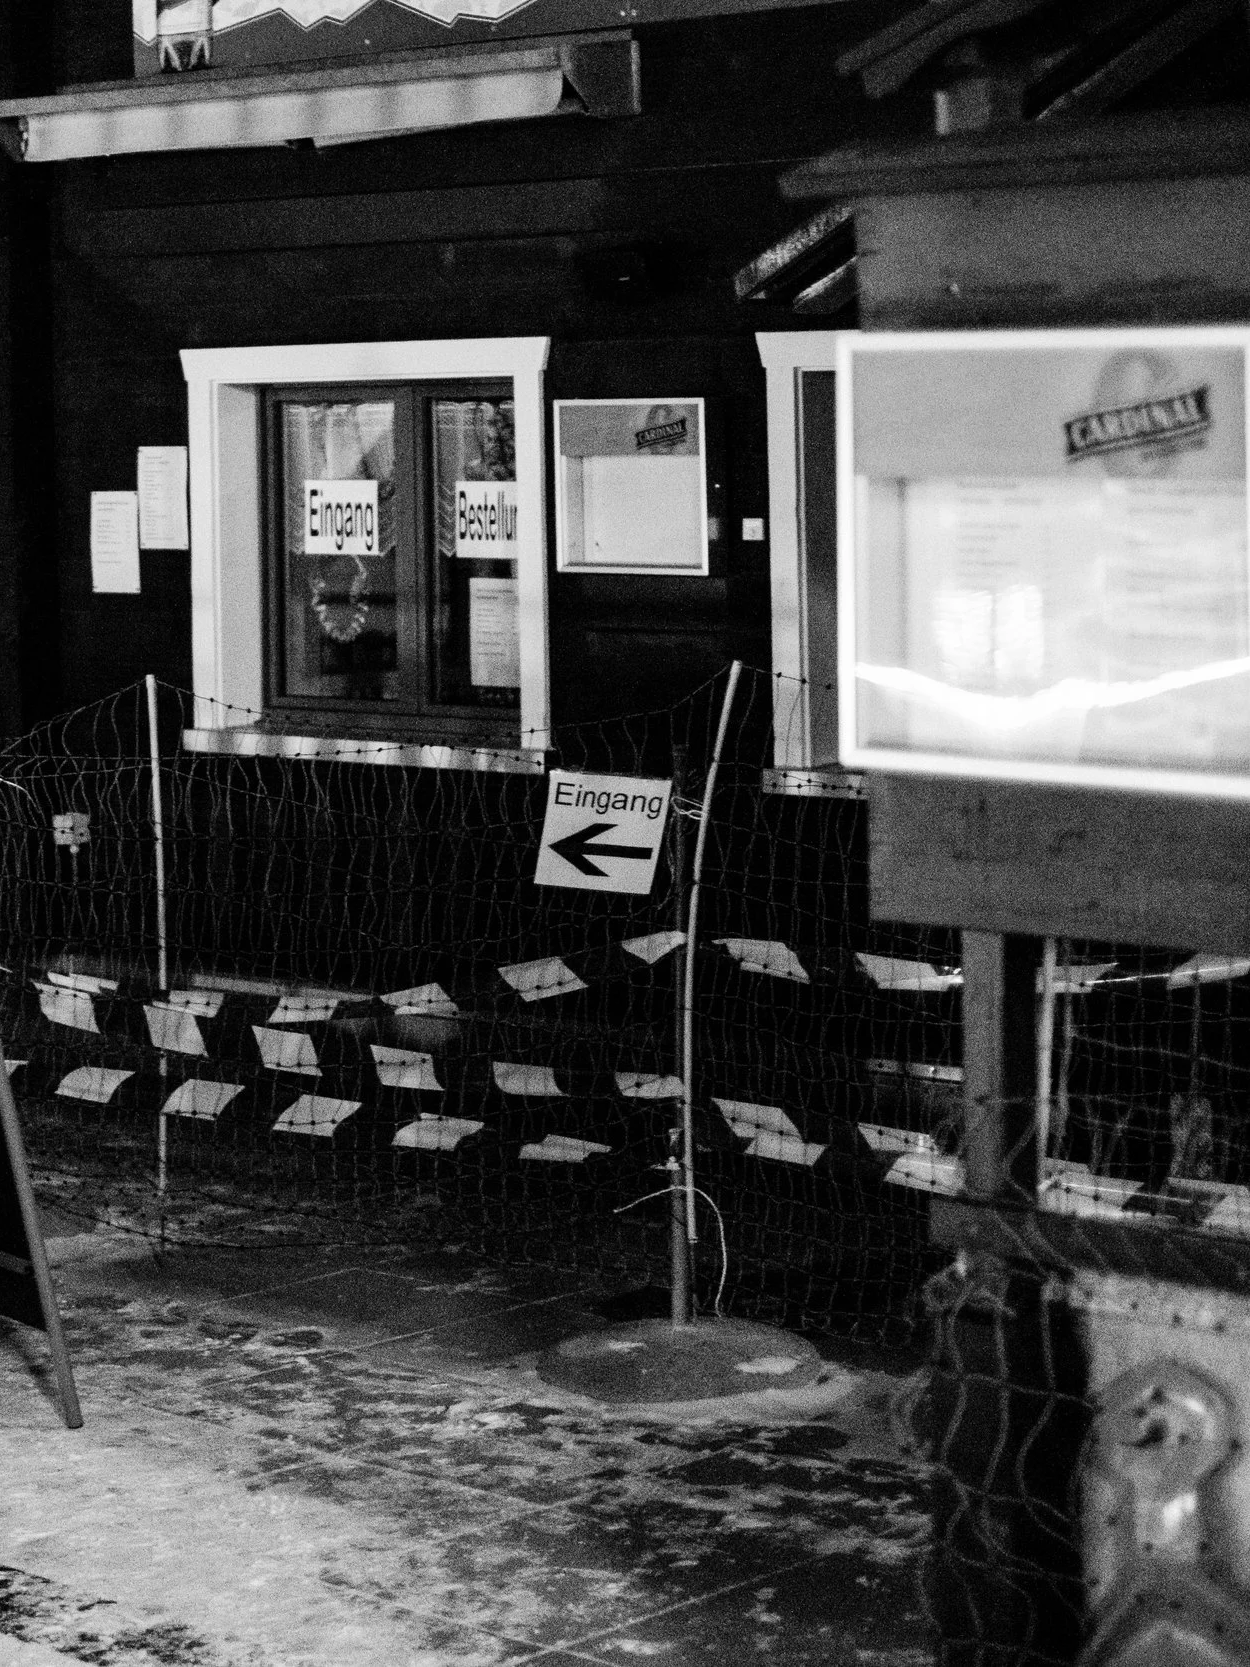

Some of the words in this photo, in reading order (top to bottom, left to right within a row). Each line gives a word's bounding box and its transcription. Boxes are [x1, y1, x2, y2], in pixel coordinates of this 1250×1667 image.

[1070, 393, 1202, 450] CARDINAL
[309, 488, 374, 551] Eingang
[554, 781, 663, 820] Eingang
